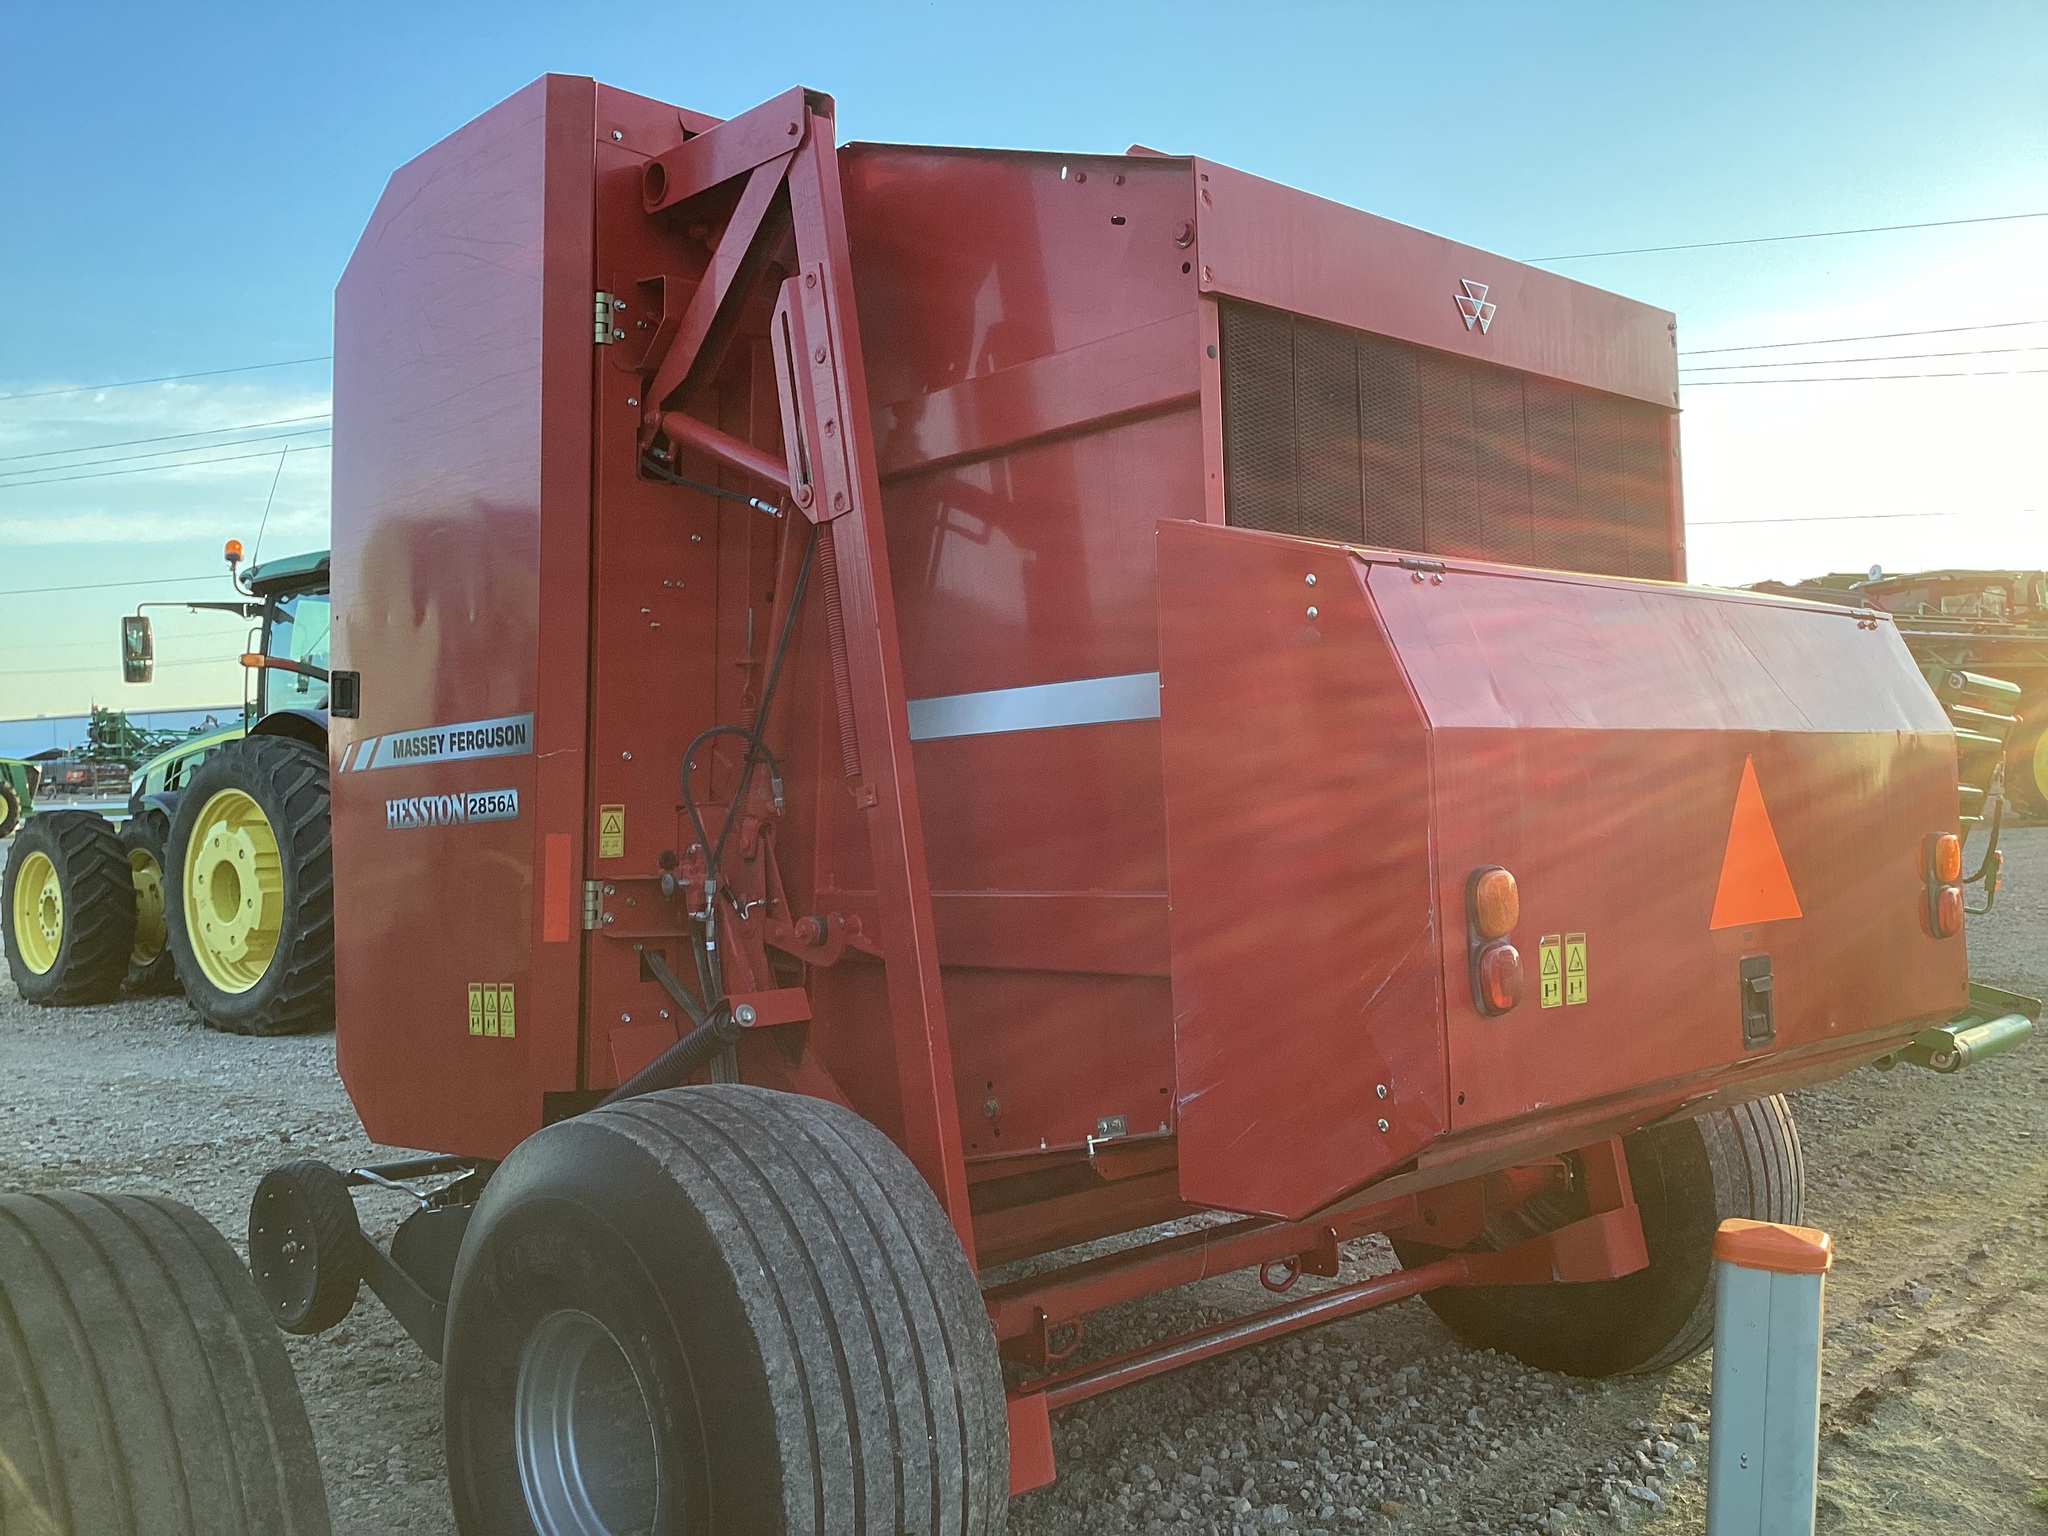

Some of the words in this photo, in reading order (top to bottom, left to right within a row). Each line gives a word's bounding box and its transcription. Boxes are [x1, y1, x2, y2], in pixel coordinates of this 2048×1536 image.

[393, 734, 445, 759] MASSEY
[449, 724, 526, 753] FERGUSON
[386, 793, 466, 829] HESSTON
[469, 794, 516, 816] 2856A
